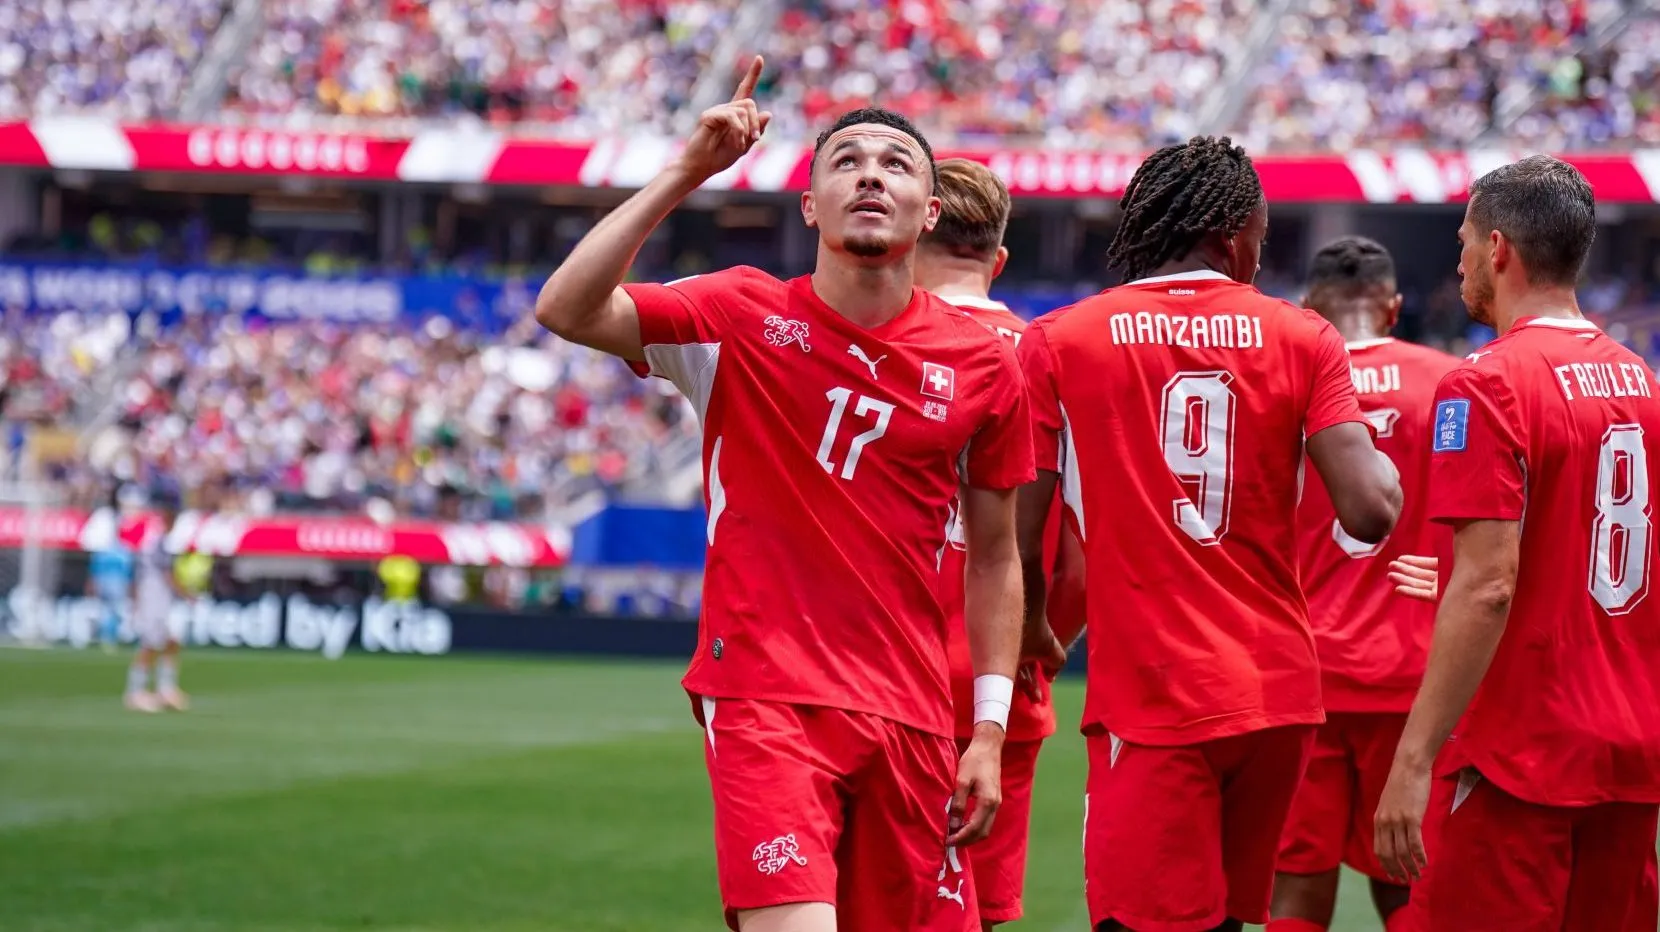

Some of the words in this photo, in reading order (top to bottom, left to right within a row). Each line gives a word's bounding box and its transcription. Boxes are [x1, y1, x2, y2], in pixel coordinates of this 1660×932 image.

[1109, 311, 1264, 349] MANZAMBI
[1351, 364, 1400, 393] ANJI
[1554, 362, 1652, 400] FREULER
[816, 386, 897, 480] 17
[1159, 370, 1236, 547] 9
[1588, 423, 1653, 616] 8
[6, 586, 280, 649] Suprted
[286, 594, 357, 659] by
[362, 594, 453, 655] Kia
